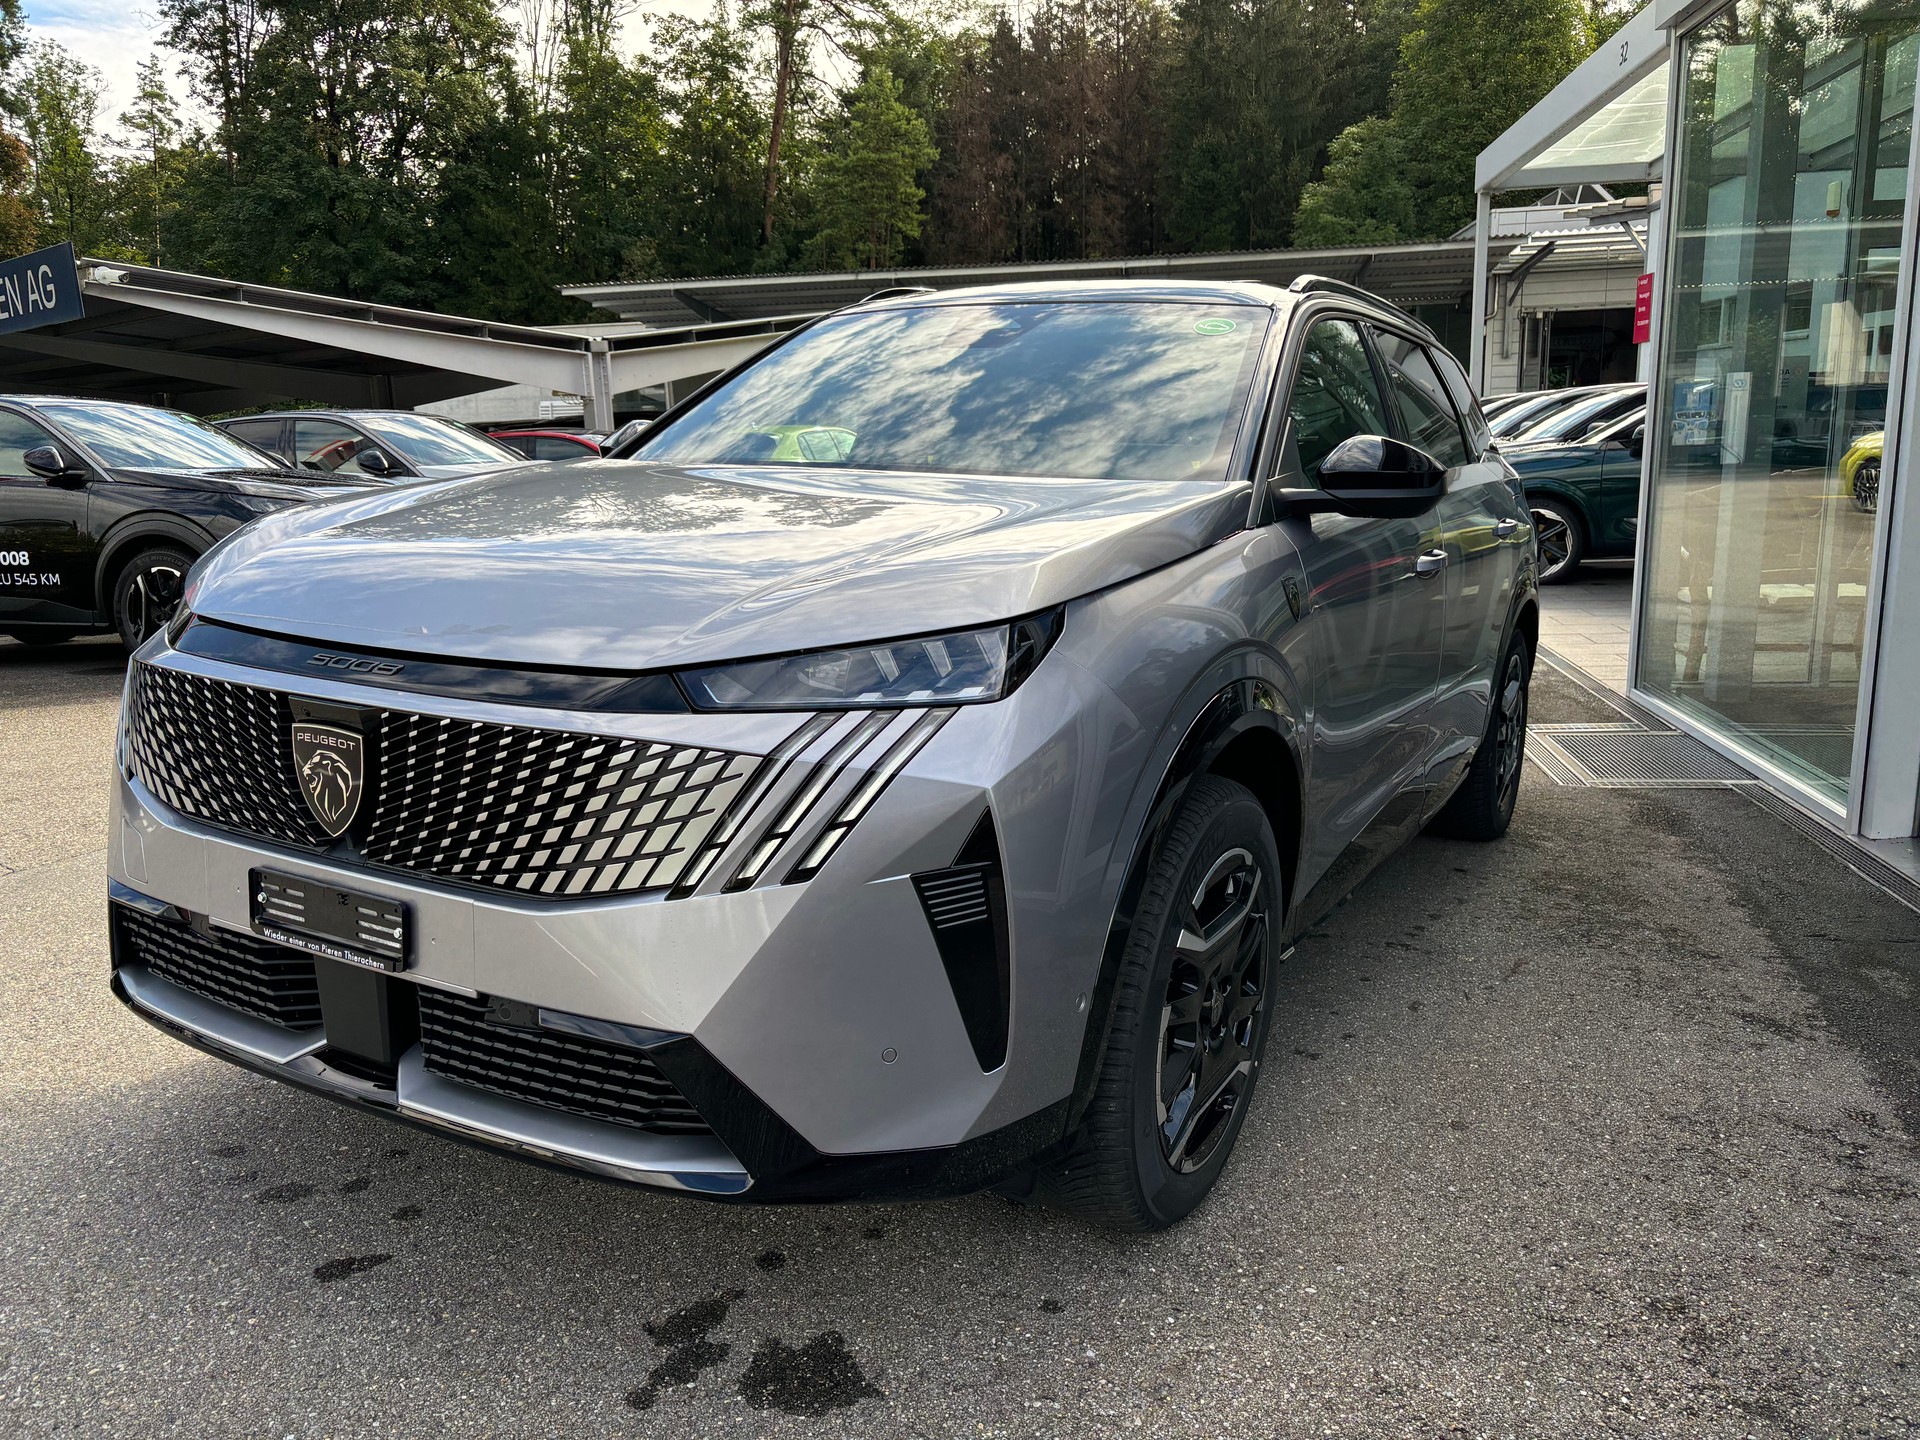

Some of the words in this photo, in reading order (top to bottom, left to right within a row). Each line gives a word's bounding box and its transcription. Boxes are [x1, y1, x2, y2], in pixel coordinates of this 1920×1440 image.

[1619, 41, 1629, 67] 32
[27, 264, 56, 313] AG
[0, 573, 11, 585] U
[14, 573, 38, 585] 545
[40, 573, 61, 585] KM
[306, 653, 405, 676] 5008
[296, 732, 356, 751] PEUGEOT
[263, 927, 288, 942] Wieder
[289, 936, 306, 947] einer
[307, 942, 320, 952] von
[321, 943, 343, 958] Pieren
